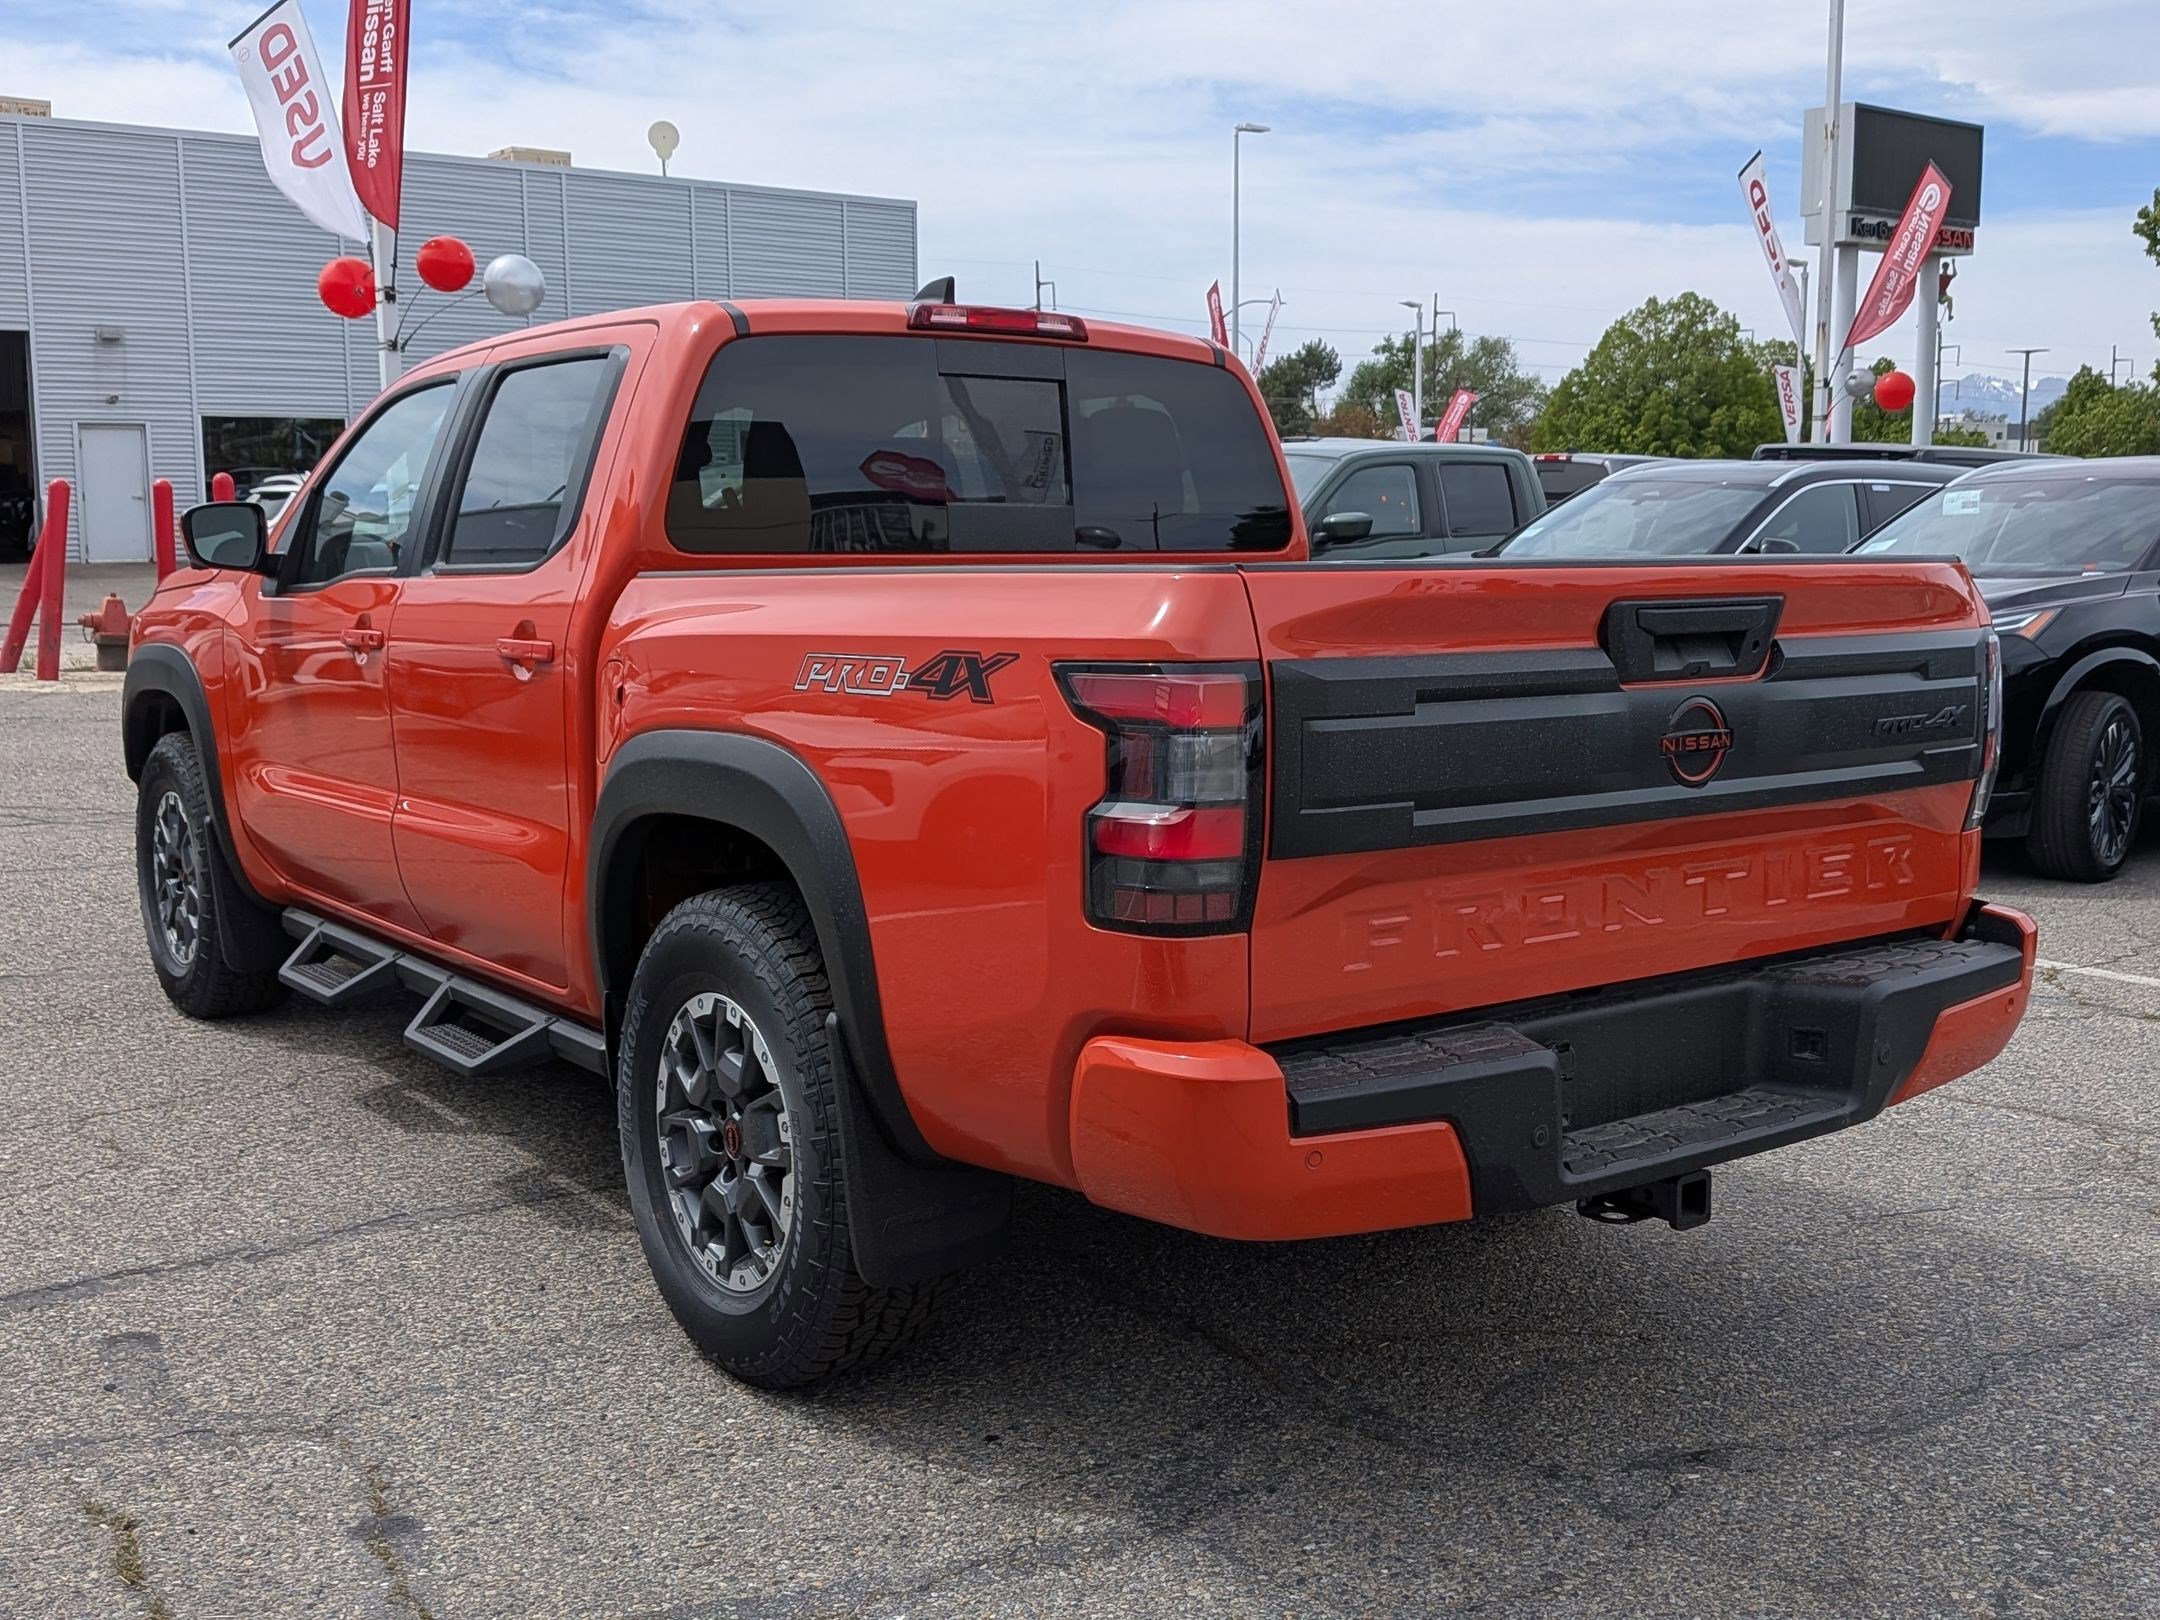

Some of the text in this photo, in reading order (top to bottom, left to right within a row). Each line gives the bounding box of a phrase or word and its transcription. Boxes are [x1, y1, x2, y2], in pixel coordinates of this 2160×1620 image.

[380, 0, 395, 73] en Garff
[361, 92, 370, 111] we
[356, 141, 367, 161] you
[366, 91, 387, 169] Salt Lake
[1398, 393, 1418, 442] SENTRA
[1779, 369, 1797, 427] VERSA
[1662, 734, 1732, 752] NISSAN
[1342, 833, 1914, 972] FRONTIER
